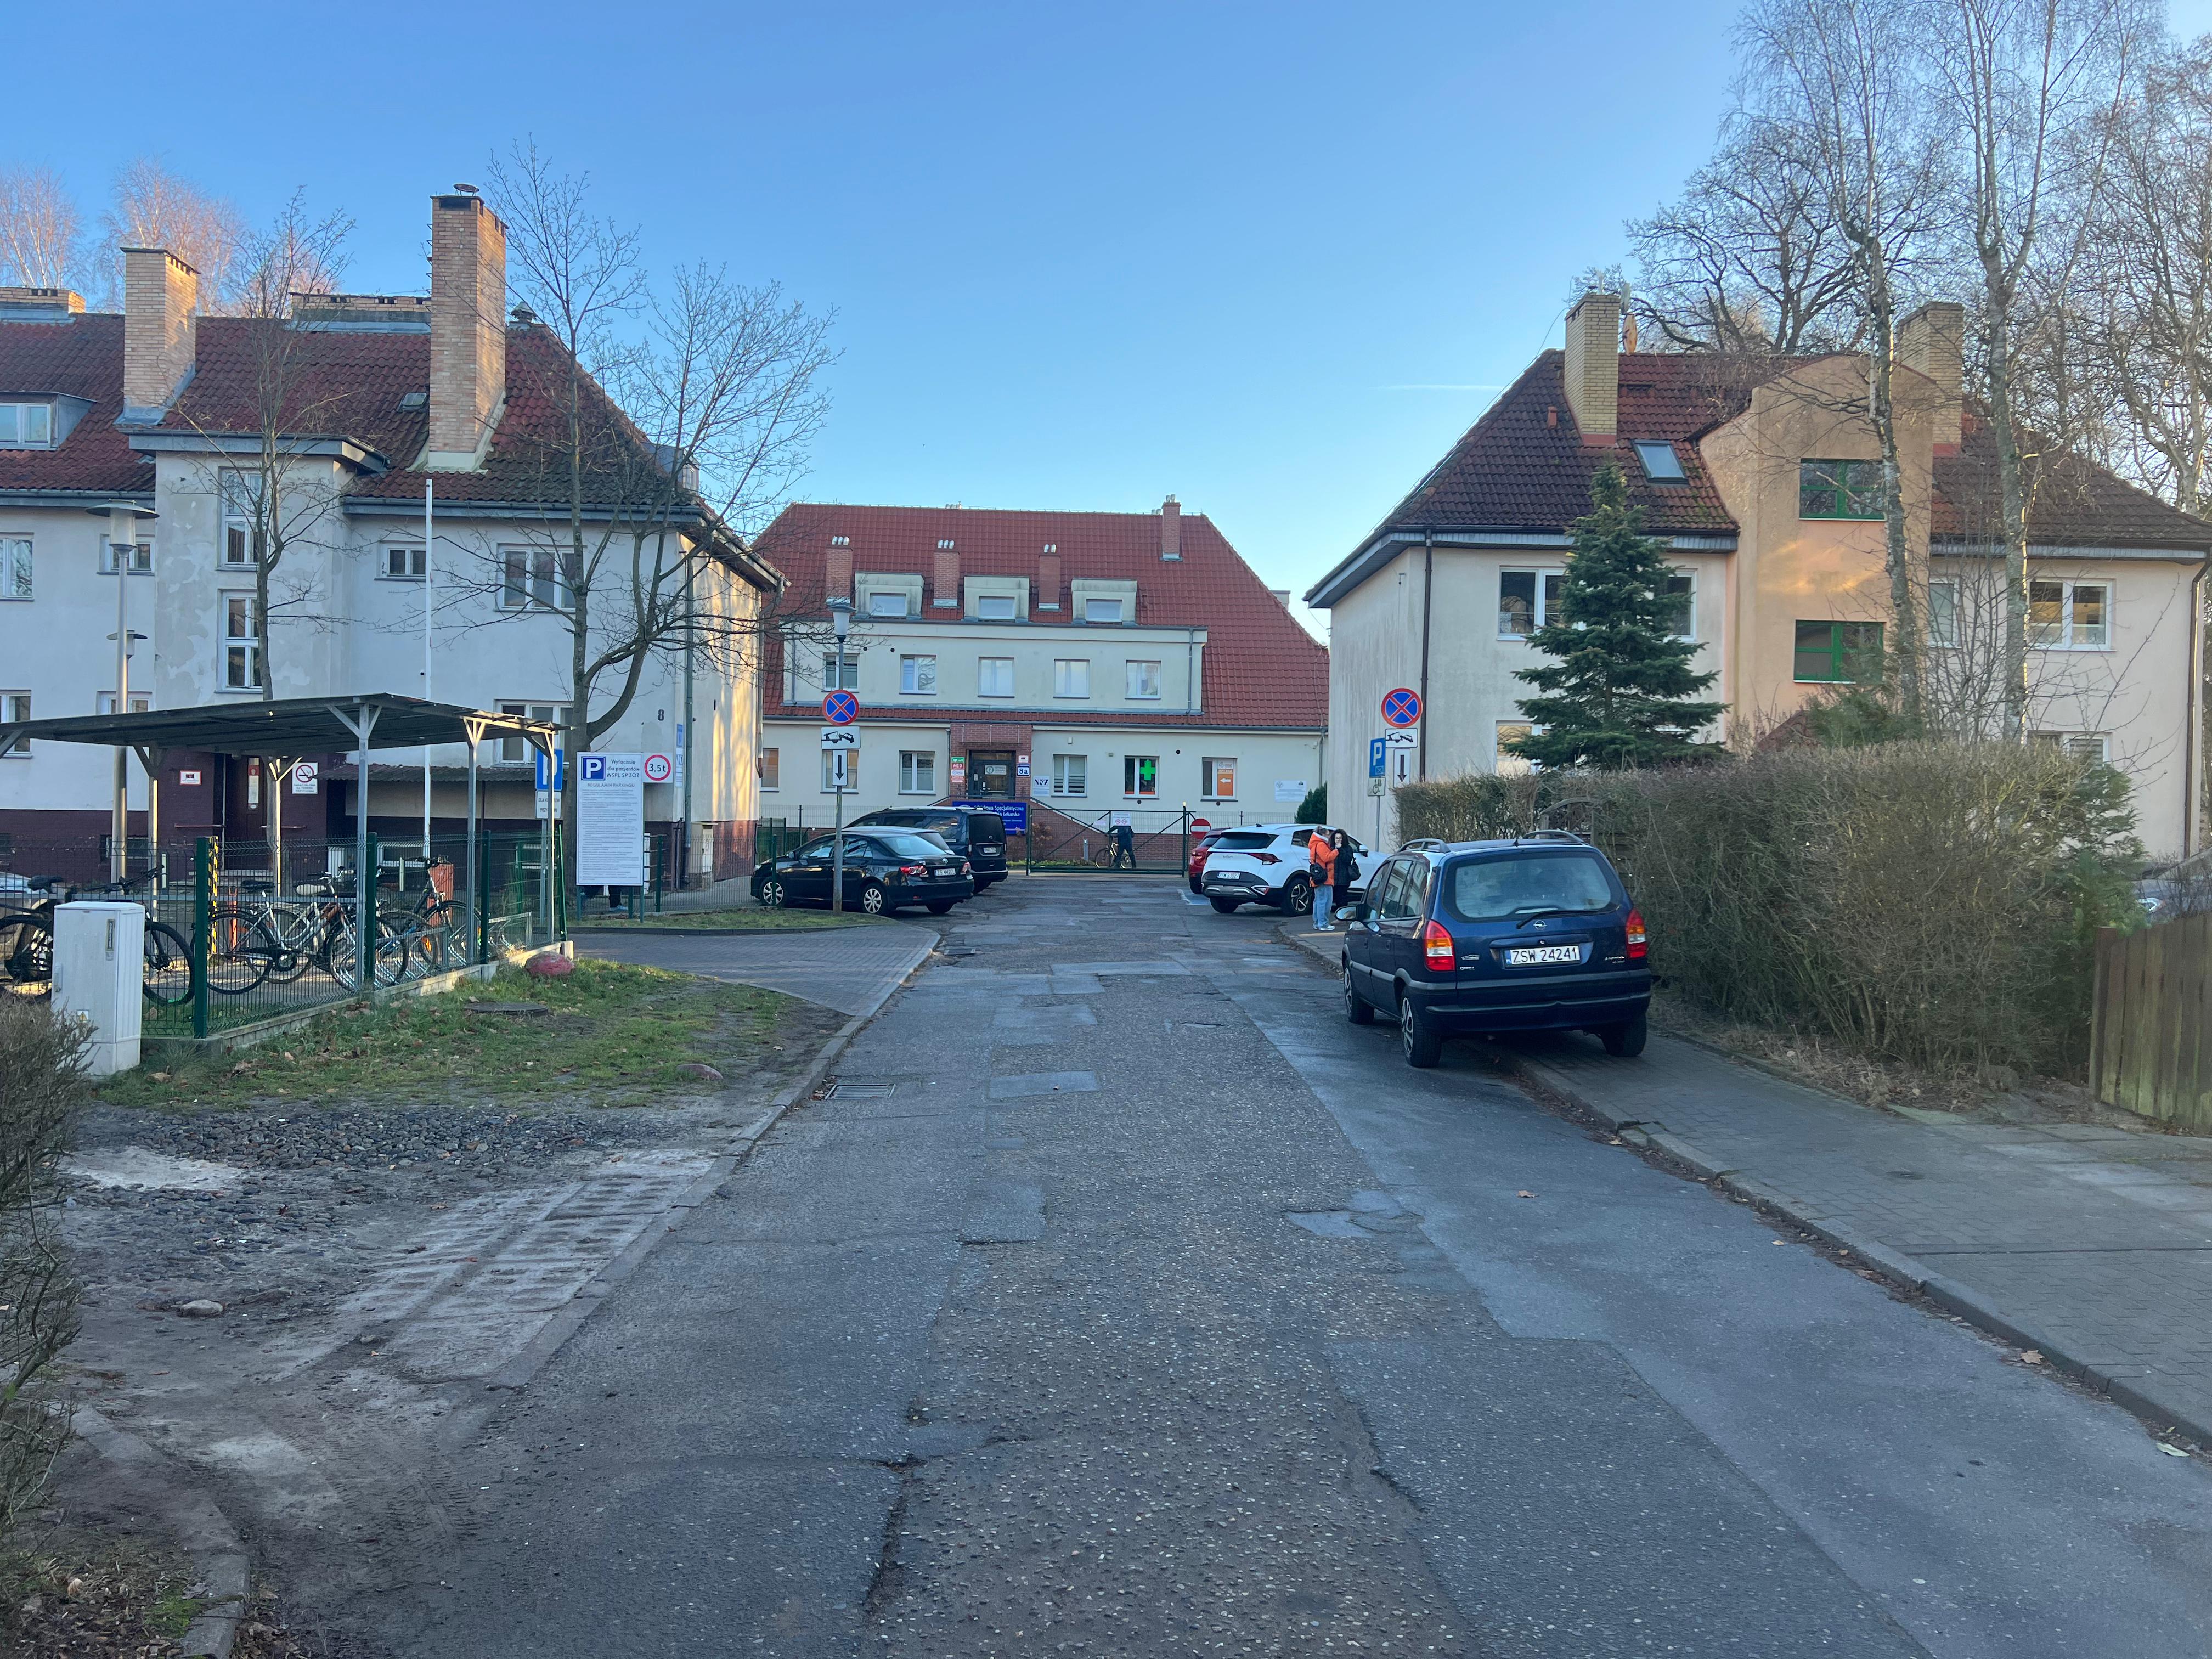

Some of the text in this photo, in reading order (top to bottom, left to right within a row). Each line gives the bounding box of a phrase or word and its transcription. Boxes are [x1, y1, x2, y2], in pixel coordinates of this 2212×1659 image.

[658, 709, 664, 721] 8
[1373, 742, 1382, 766] P
[586, 759, 602, 778] P
[1512, 947, 1577, 963] ZSW 24241
